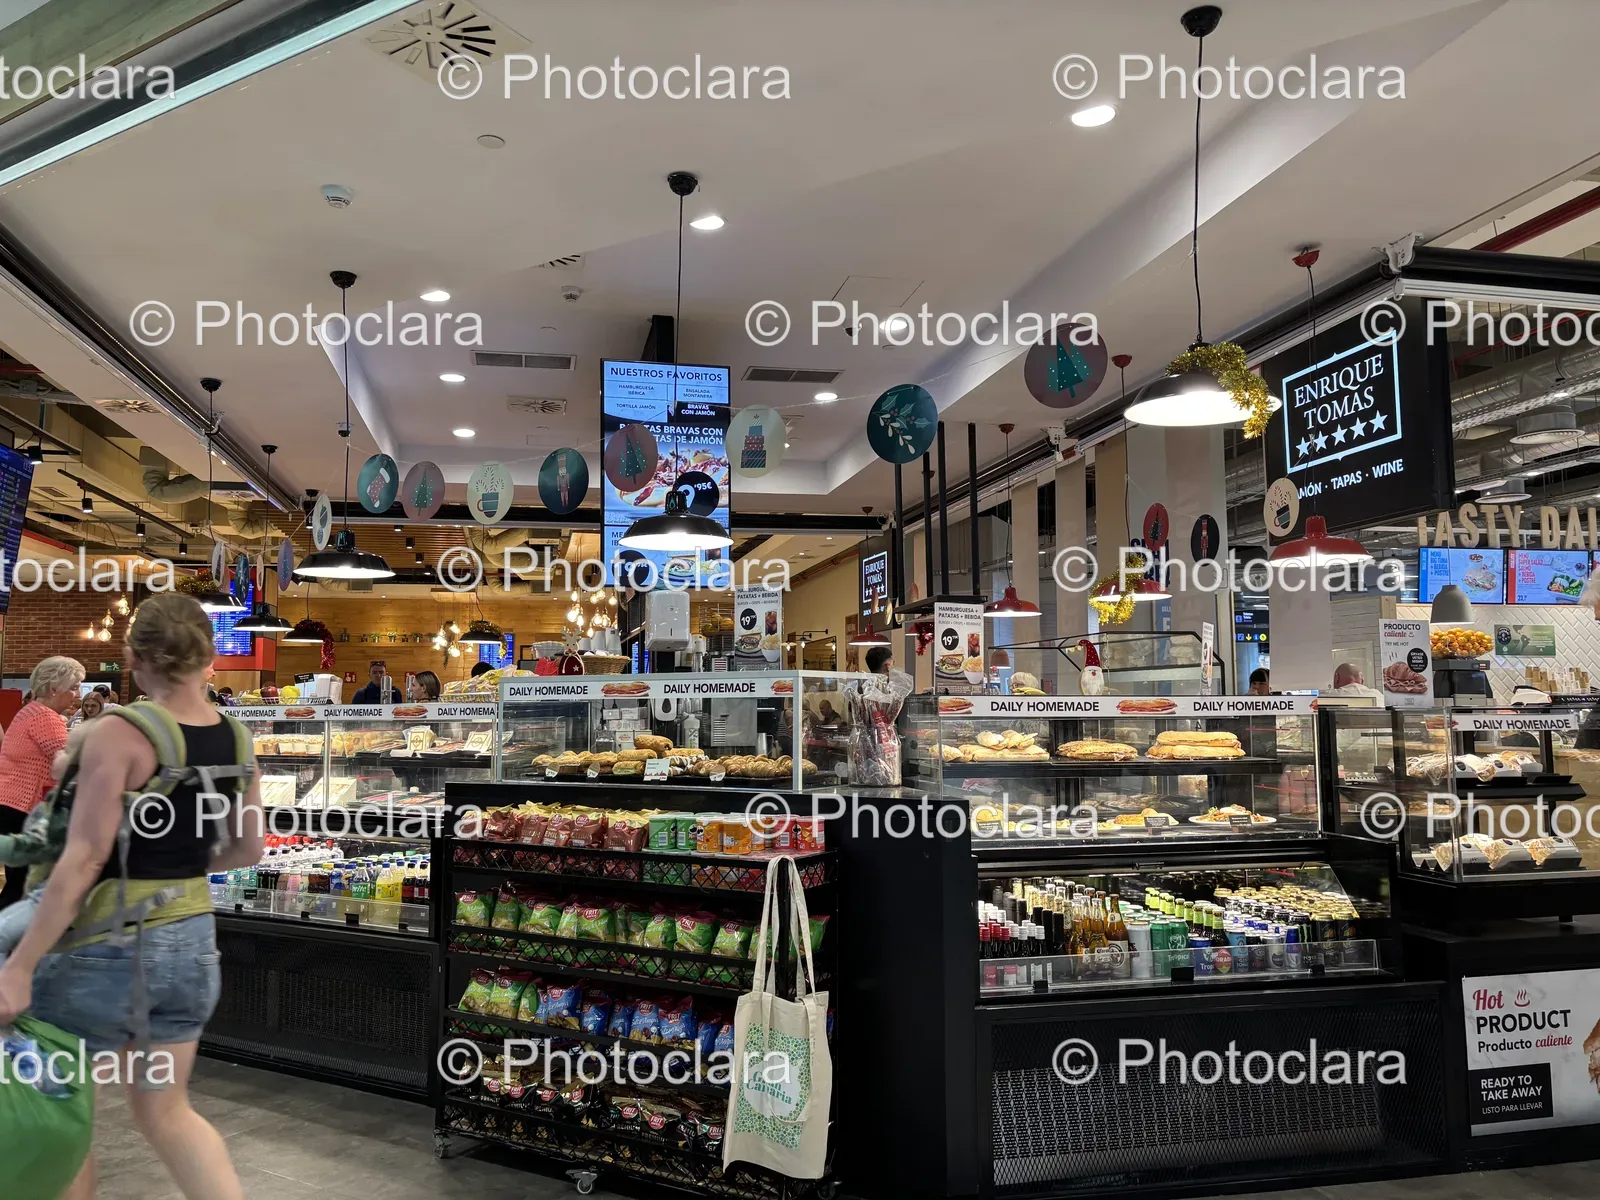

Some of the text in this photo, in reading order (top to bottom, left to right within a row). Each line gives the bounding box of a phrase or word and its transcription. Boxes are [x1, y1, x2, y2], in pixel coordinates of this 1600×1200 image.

[610, 367, 722, 381] NUESTROS FAVORITOS
[1294, 354, 1384, 408] ENRIQUE
[1303, 386, 1374, 430] TOMAS
[664, 426, 700, 435] BRAVAS
[702, 428, 723, 436] CON
[688, 436, 723, 445] JAMÓN
[1331, 470, 1362, 490] TAPAS
[1371, 459, 1404, 480] WINE
[509, 685, 588, 696] DAILY HOMEMADE
[663, 682, 756, 694] DAILY HOMEMADE
[437, 707, 495, 716] DAILY HOMEMA
[990, 700, 1100, 713] DAILY HOMEMADE
[1193, 700, 1294, 711] DAILY HOMEMADE
[241, 709, 276, 718] HOMEMADE
[324, 708, 382, 717] DAILY HOMEMADE
[1473, 719, 1572, 730] DAILY HOMEMADE
[1472, 989, 1505, 1011] Hot
[640, 1003, 652, 1011] FRIT
[1476, 1009, 1571, 1035] PRODUCT
[1478, 1034, 1573, 1053] Producto caliente
[1481, 1074, 1532, 1089] READY TO
[746, 1079, 792, 1105] Canaria
[1481, 1085, 1543, 1101] TAKE AWAY
[1482, 1101, 1543, 1115] LISTO PARA LLEVAR
[650, 1116, 664, 1124] FRIT
